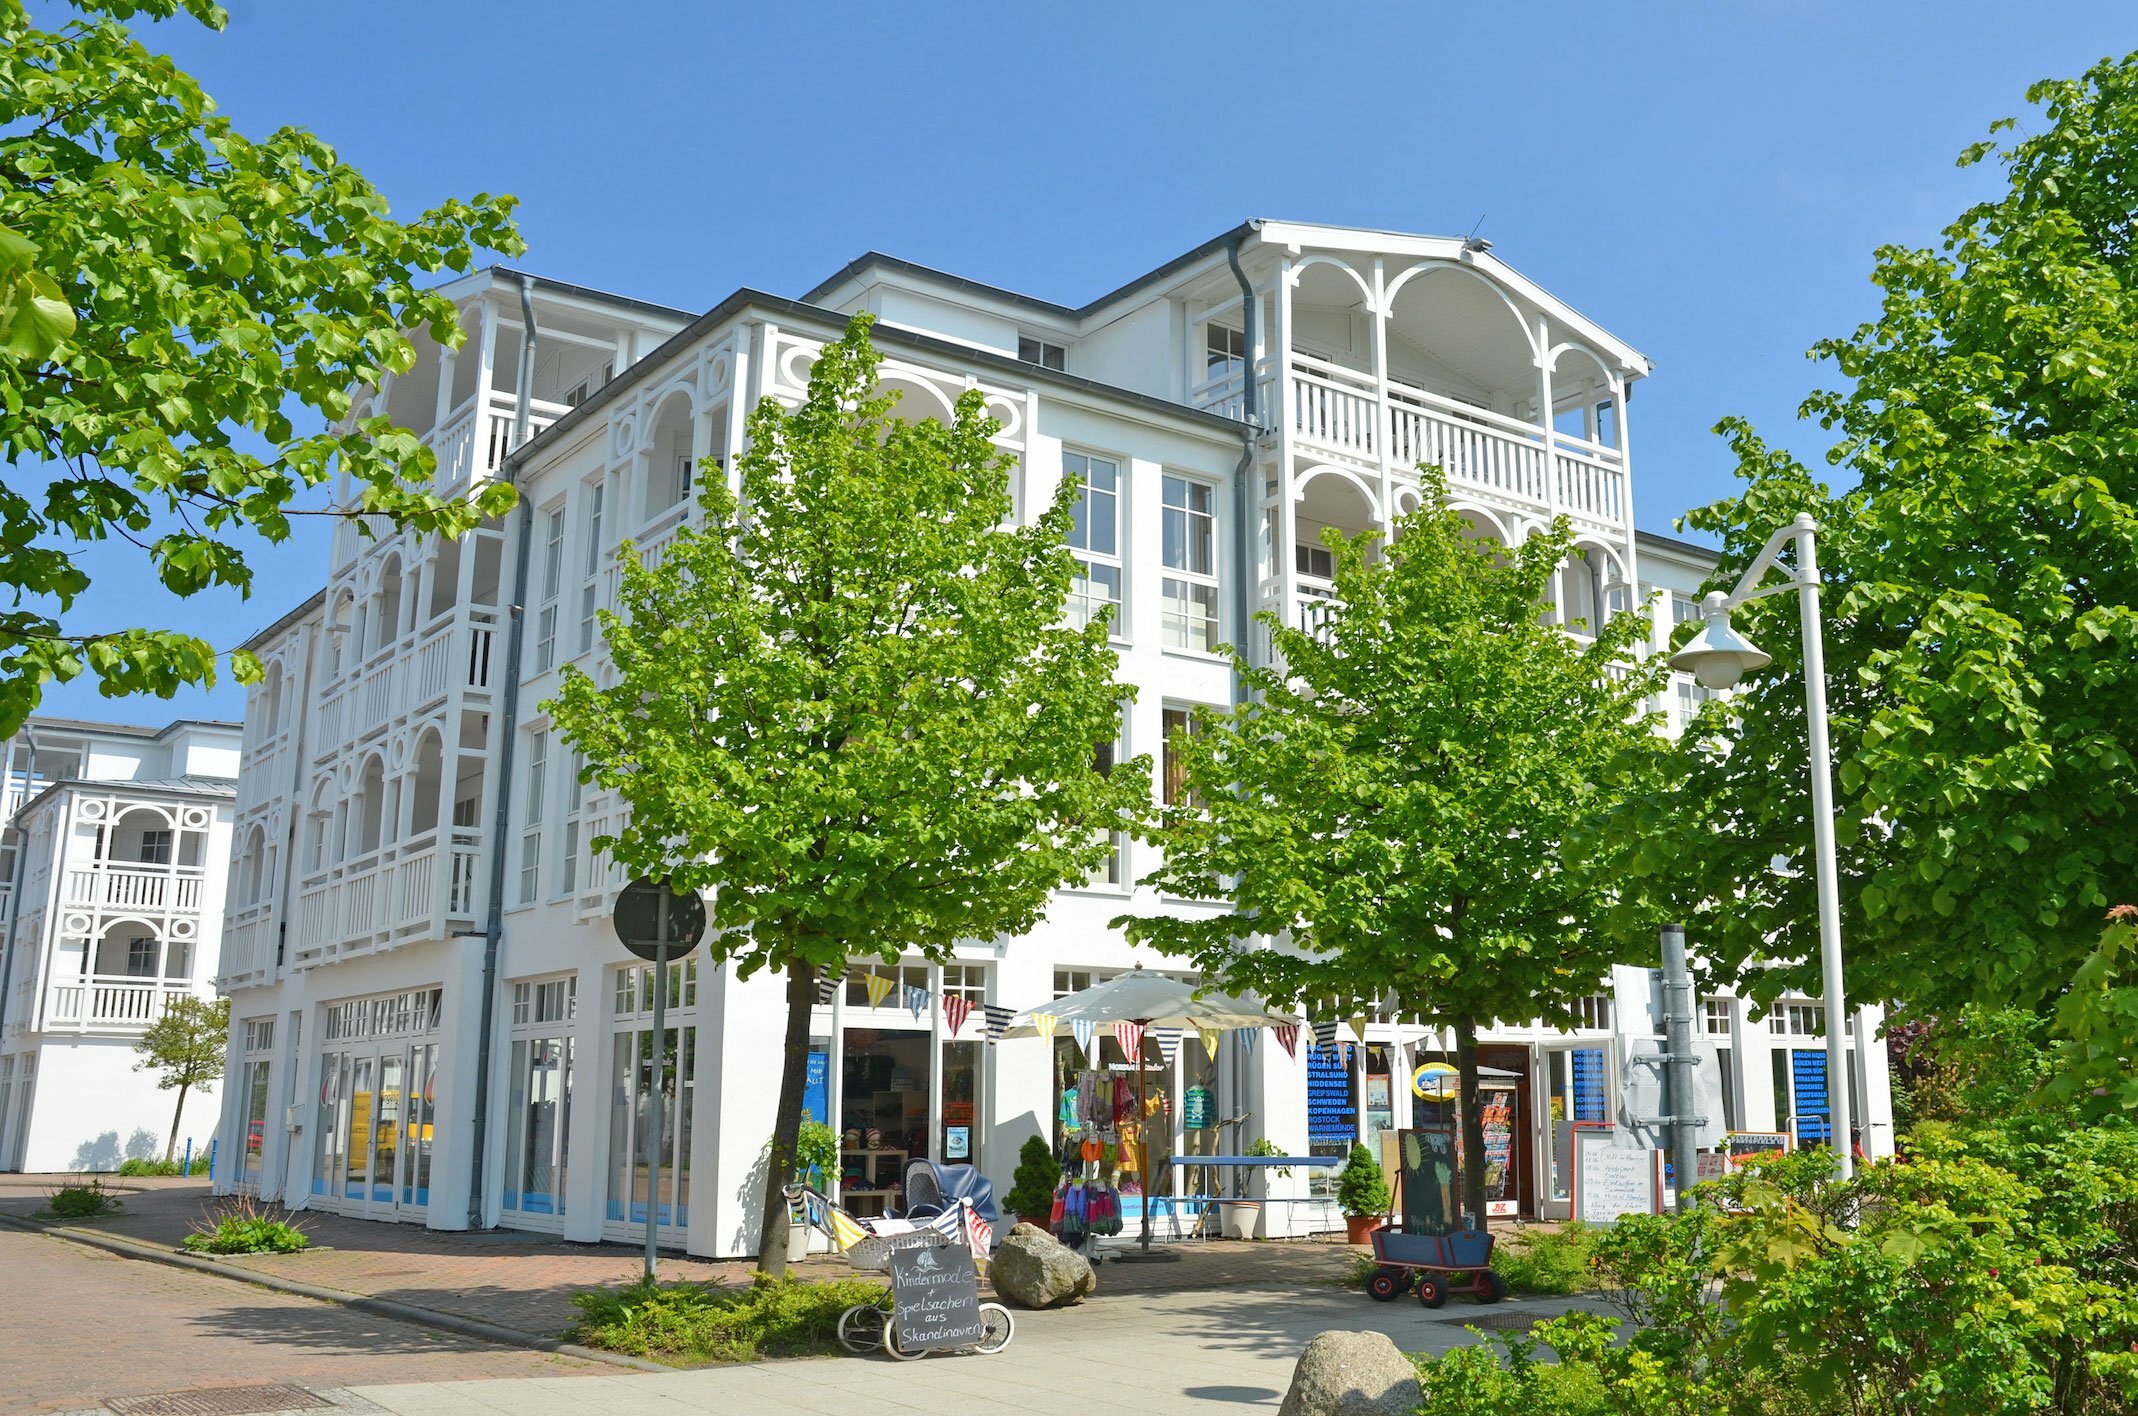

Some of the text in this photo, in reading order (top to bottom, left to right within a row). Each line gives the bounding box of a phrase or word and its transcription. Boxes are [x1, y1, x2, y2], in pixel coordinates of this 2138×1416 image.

[1793, 1051, 1811, 1059] RÜGEN
[1794, 1058, 1811, 1067] RÜGEN
[1813, 1066, 1824, 1074] SÜD
[1795, 1075, 1824, 1083] STRALSUND
[1308, 1089, 1349, 1097] GREIFSWALD
[1797, 1099, 1825, 1107] SCHWEDEN
[1308, 1115, 1340, 1123] ROSTOCK
[1309, 1123, 1356, 1132] WARNEMÜNDE
[894, 1265, 973, 1289] Kindermode
[897, 1296, 973, 1321] Spielsachen
[925, 1313, 947, 1322] aus
[902, 1323, 981, 1344] Skandinavien
